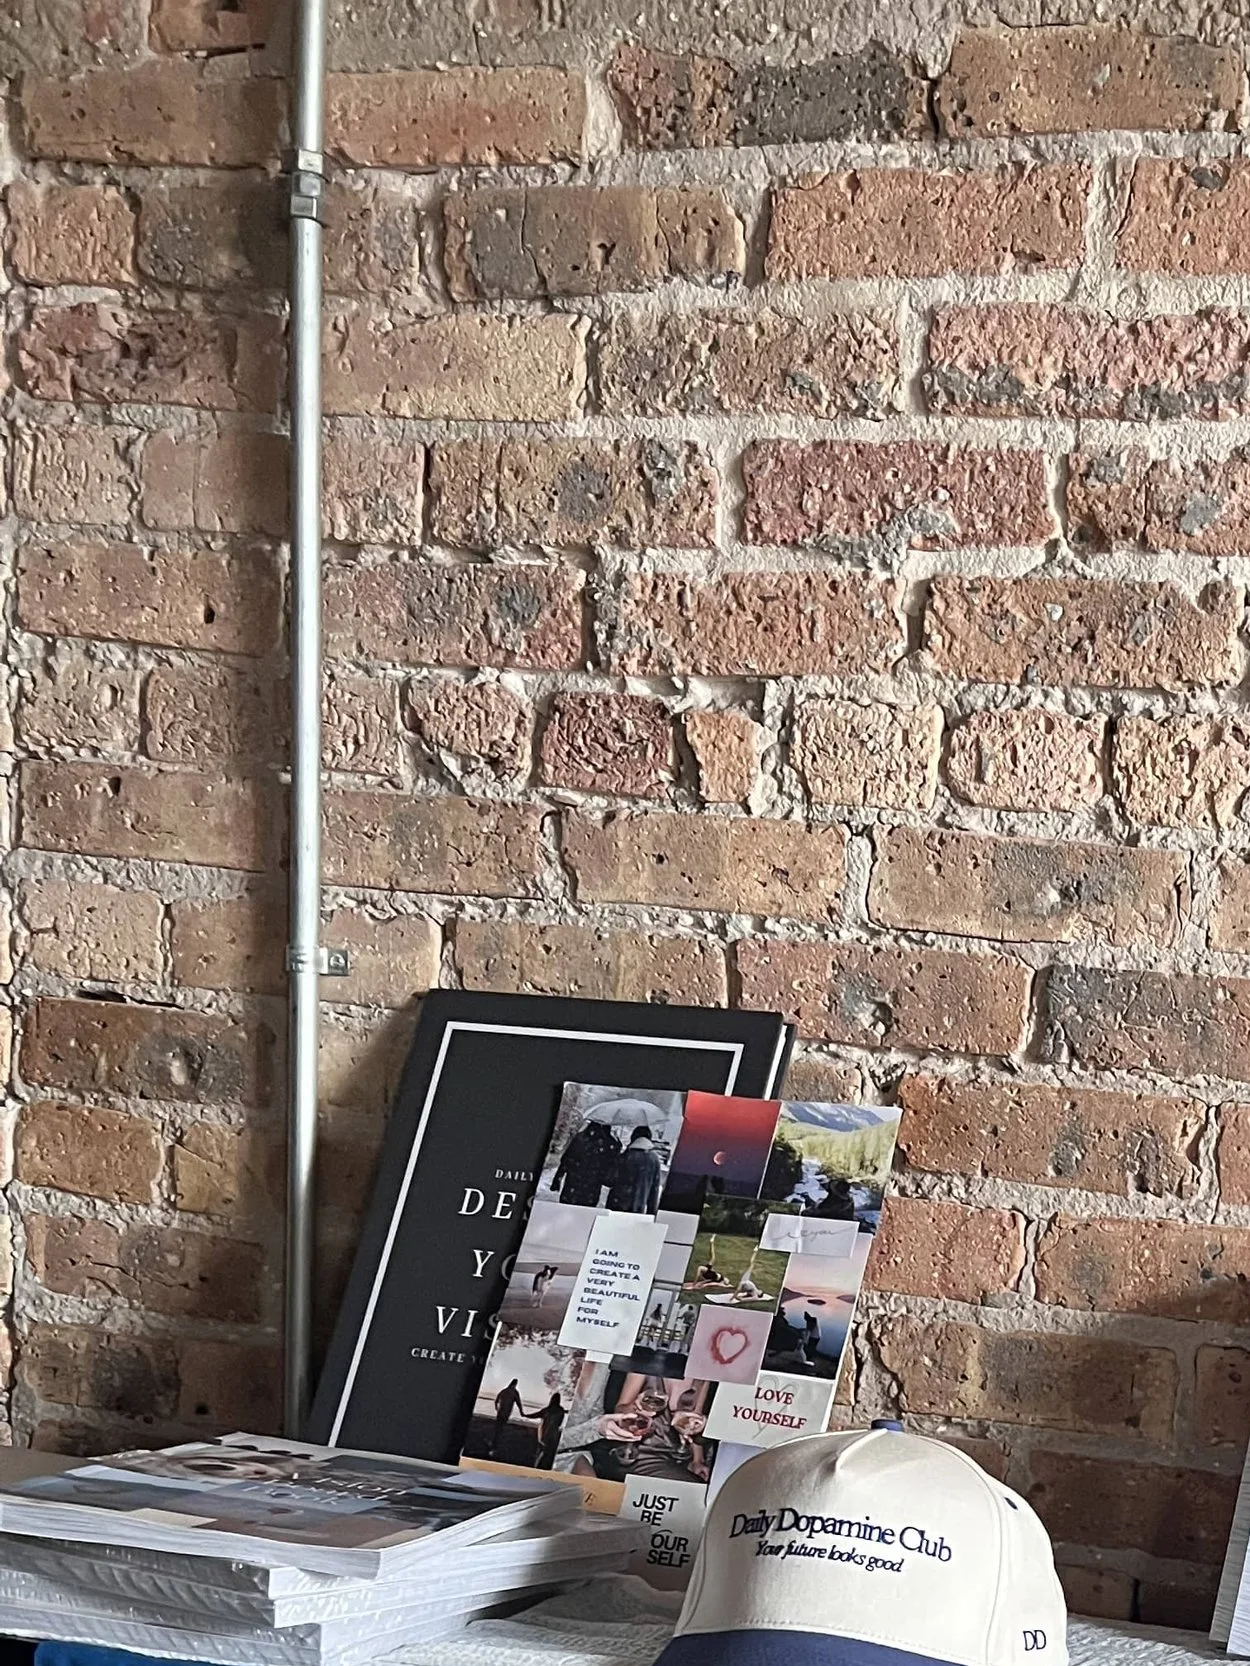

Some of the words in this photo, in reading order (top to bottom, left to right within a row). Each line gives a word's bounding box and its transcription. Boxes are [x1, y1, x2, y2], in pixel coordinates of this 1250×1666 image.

[601, 1249, 619, 1257] AM
[592, 1258, 625, 1269] GOING
[627, 1263, 640, 1271] TO
[589, 1268, 631, 1279] CREATE
[587, 1278, 615, 1287] VERY
[580, 1297, 603, 1306] LIFE
[583, 1287, 641, 1302] BEAUTIFUL
[577, 1306, 598, 1315] FOR
[576, 1316, 620, 1328] MYSELF
[411, 1347, 466, 1363] CREATE
[755, 1387, 794, 1405] LOVE
[733, 1406, 807, 1429] YOURSELF
[632, 1494, 679, 1512] JUST
[640, 1510, 664, 1526] BE
[650, 1533, 689, 1552] OUR
[729, 1509, 777, 1538] Daily
[773, 1507, 895, 1545] Dopamine
[899, 1526, 952, 1562] Club
[646, 1549, 691, 1568] SELF
[756, 1540, 784, 1556] Your
[781, 1540, 827, 1560] future
[828, 1545, 866, 1565] looks
[865, 1556, 904, 1572] good
[1023, 1629, 1047, 1651] DD
